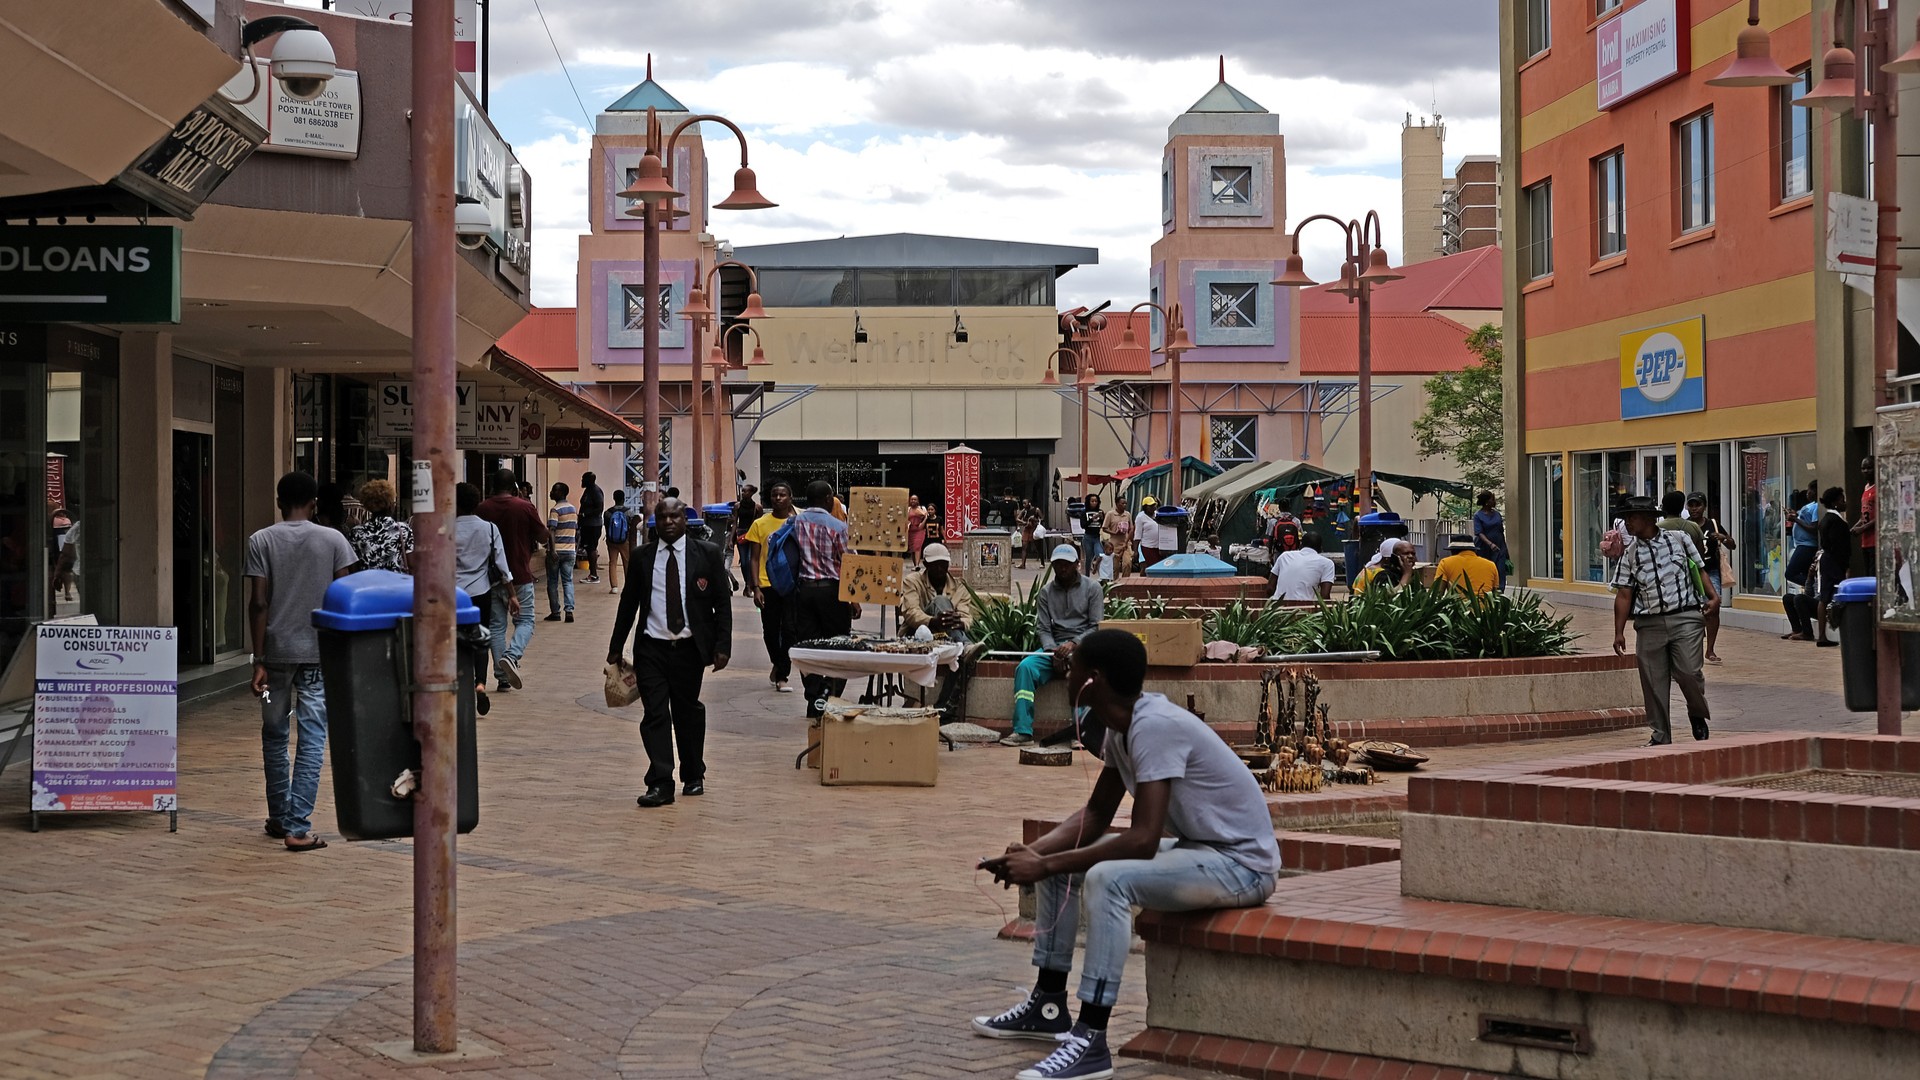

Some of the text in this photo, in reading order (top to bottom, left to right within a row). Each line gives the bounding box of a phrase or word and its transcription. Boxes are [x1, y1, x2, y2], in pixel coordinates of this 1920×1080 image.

[1602, 30, 1619, 67] broll
[1625, 18, 1667, 53] MAXIMISING
[1625, 39, 1667, 67] PROPERTY POTENTIAL
[278, 105, 354, 120] POST MALL STREET
[313, 100, 327, 108] LIFE
[329, 102, 352, 111] TOWER
[172, 110, 207, 140] 39
[293, 116, 339, 128] 081 6862038
[304, 132, 325, 140] E-MAIL:
[185, 116, 239, 161] POST
[157, 147, 211, 193] MALL
[944, 332, 1026, 364] Park
[1639, 347, 1678, 388] PEP
[970, 455, 978, 485] OPTIC
[946, 455, 956, 539] OPTIC EXCLUSIVE
[40, 628, 173, 640] ADVANCED TRAINING &
[63, 640, 149, 652] CONSULTANCY
[38, 682, 175, 694] WE WRITE PROFFESIONAL
